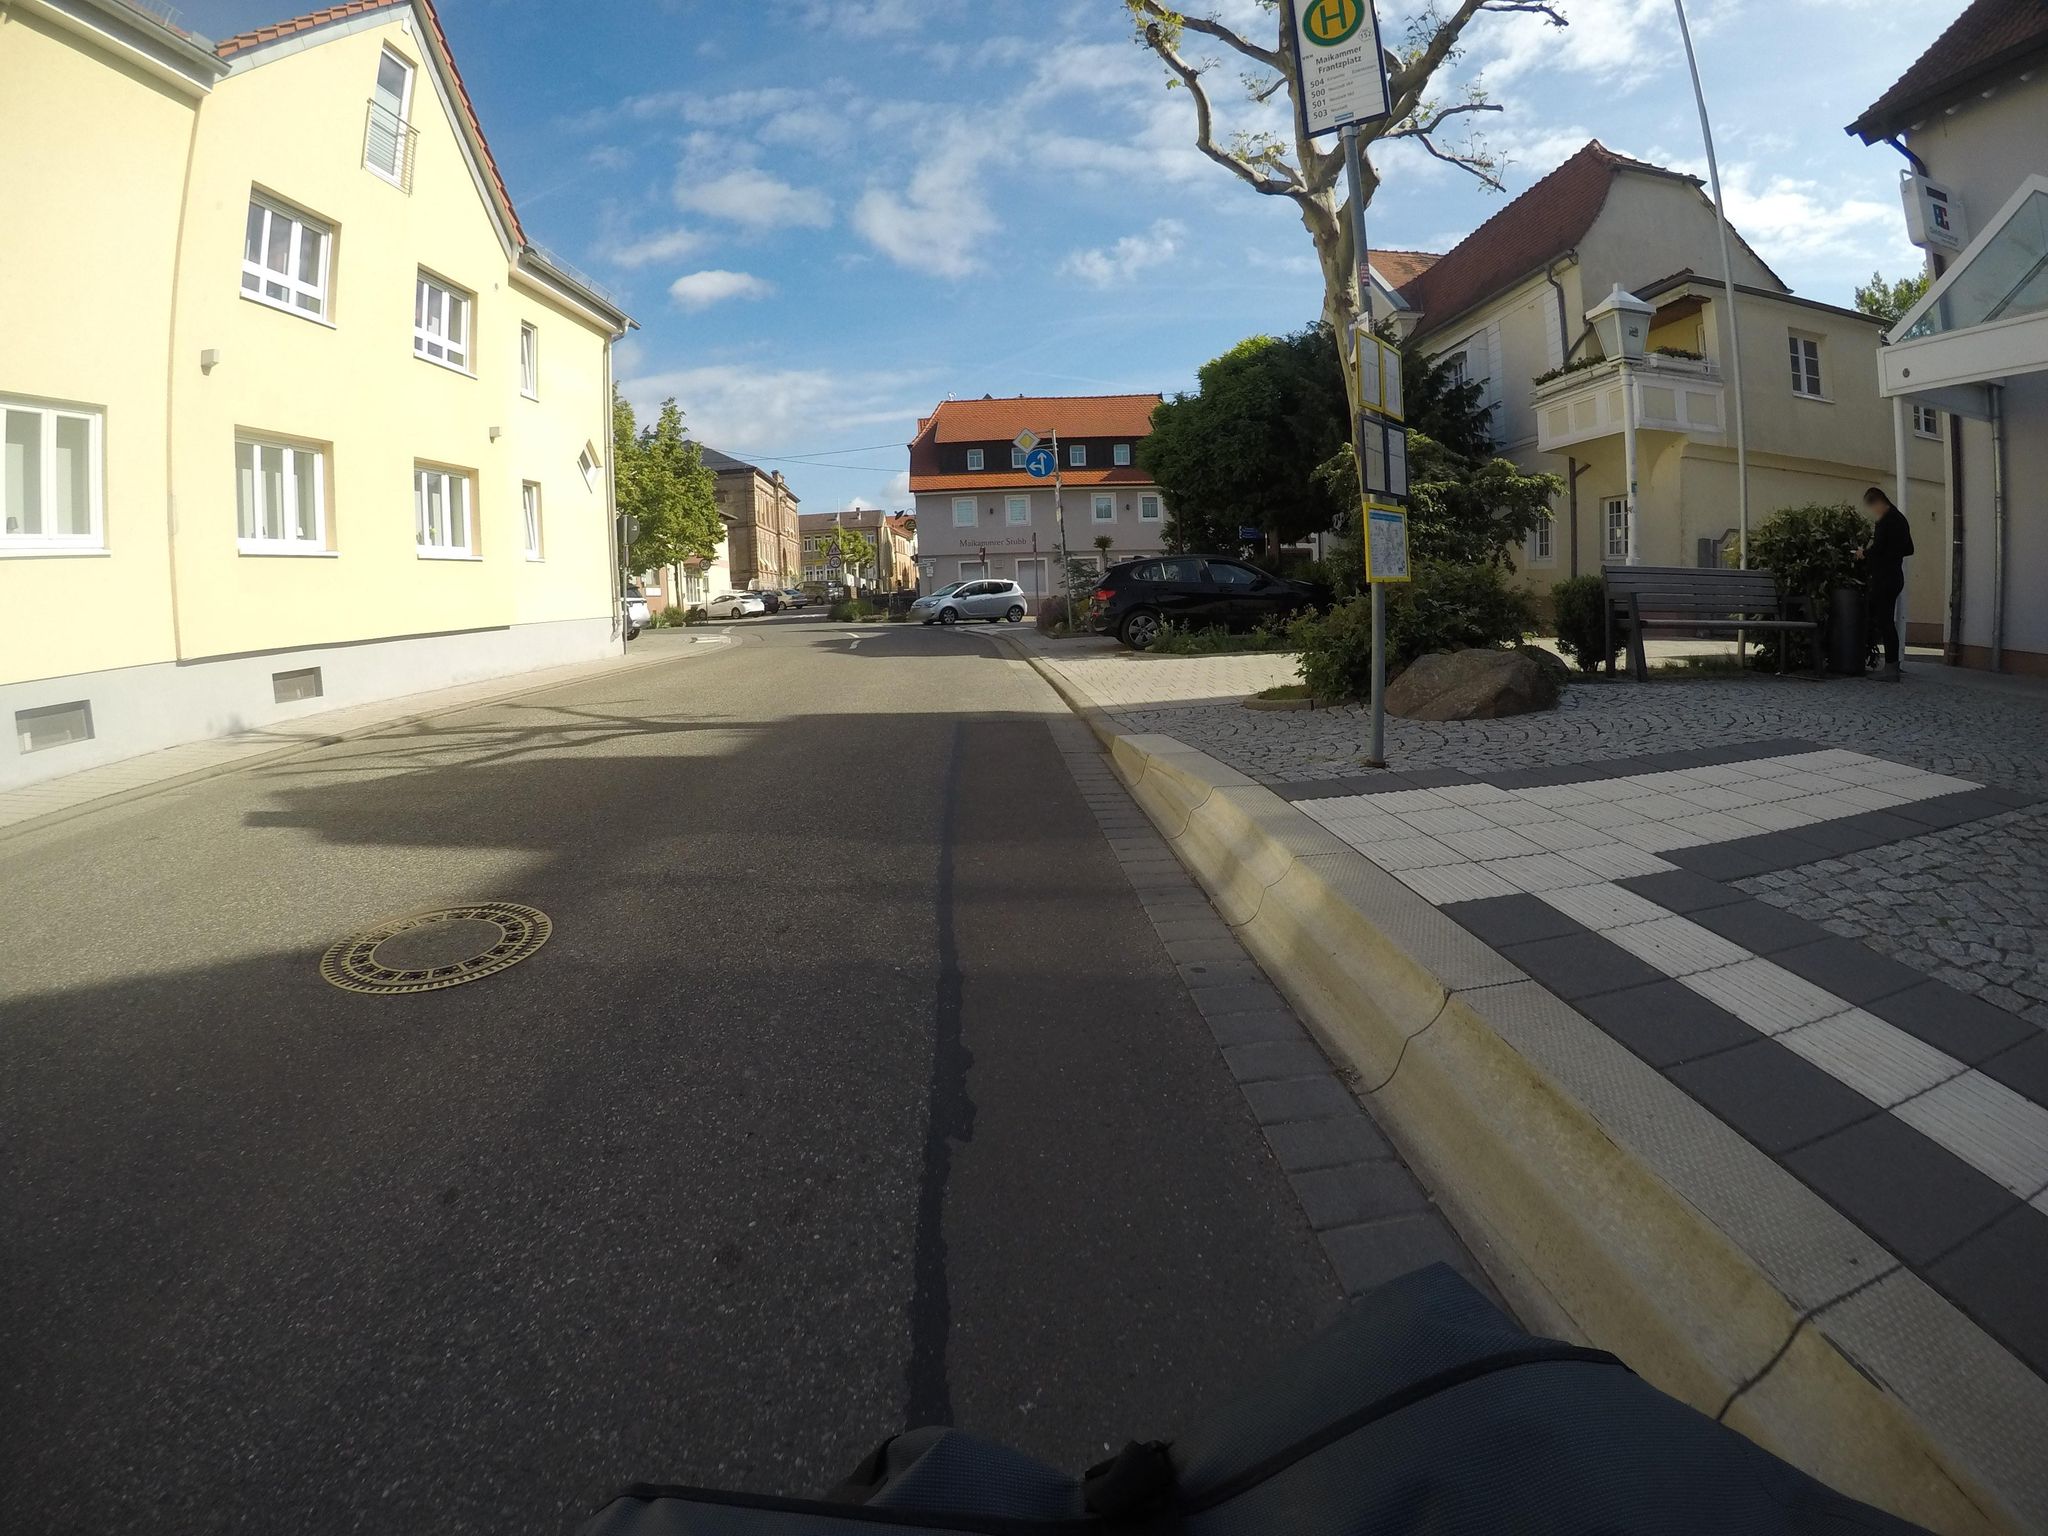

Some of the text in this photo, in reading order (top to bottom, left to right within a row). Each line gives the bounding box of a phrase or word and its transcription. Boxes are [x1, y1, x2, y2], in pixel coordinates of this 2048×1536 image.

[1319, 0, 1347, 36] H
[1315, 45, 1362, 65] Maikammer
[1318, 56, 1362, 74] Frantzplatz
[1310, 78, 1325, 89] 504
[1311, 88, 1326, 98] 500
[1312, 99, 1327, 109] 501
[1313, 109, 1328, 120] 503
